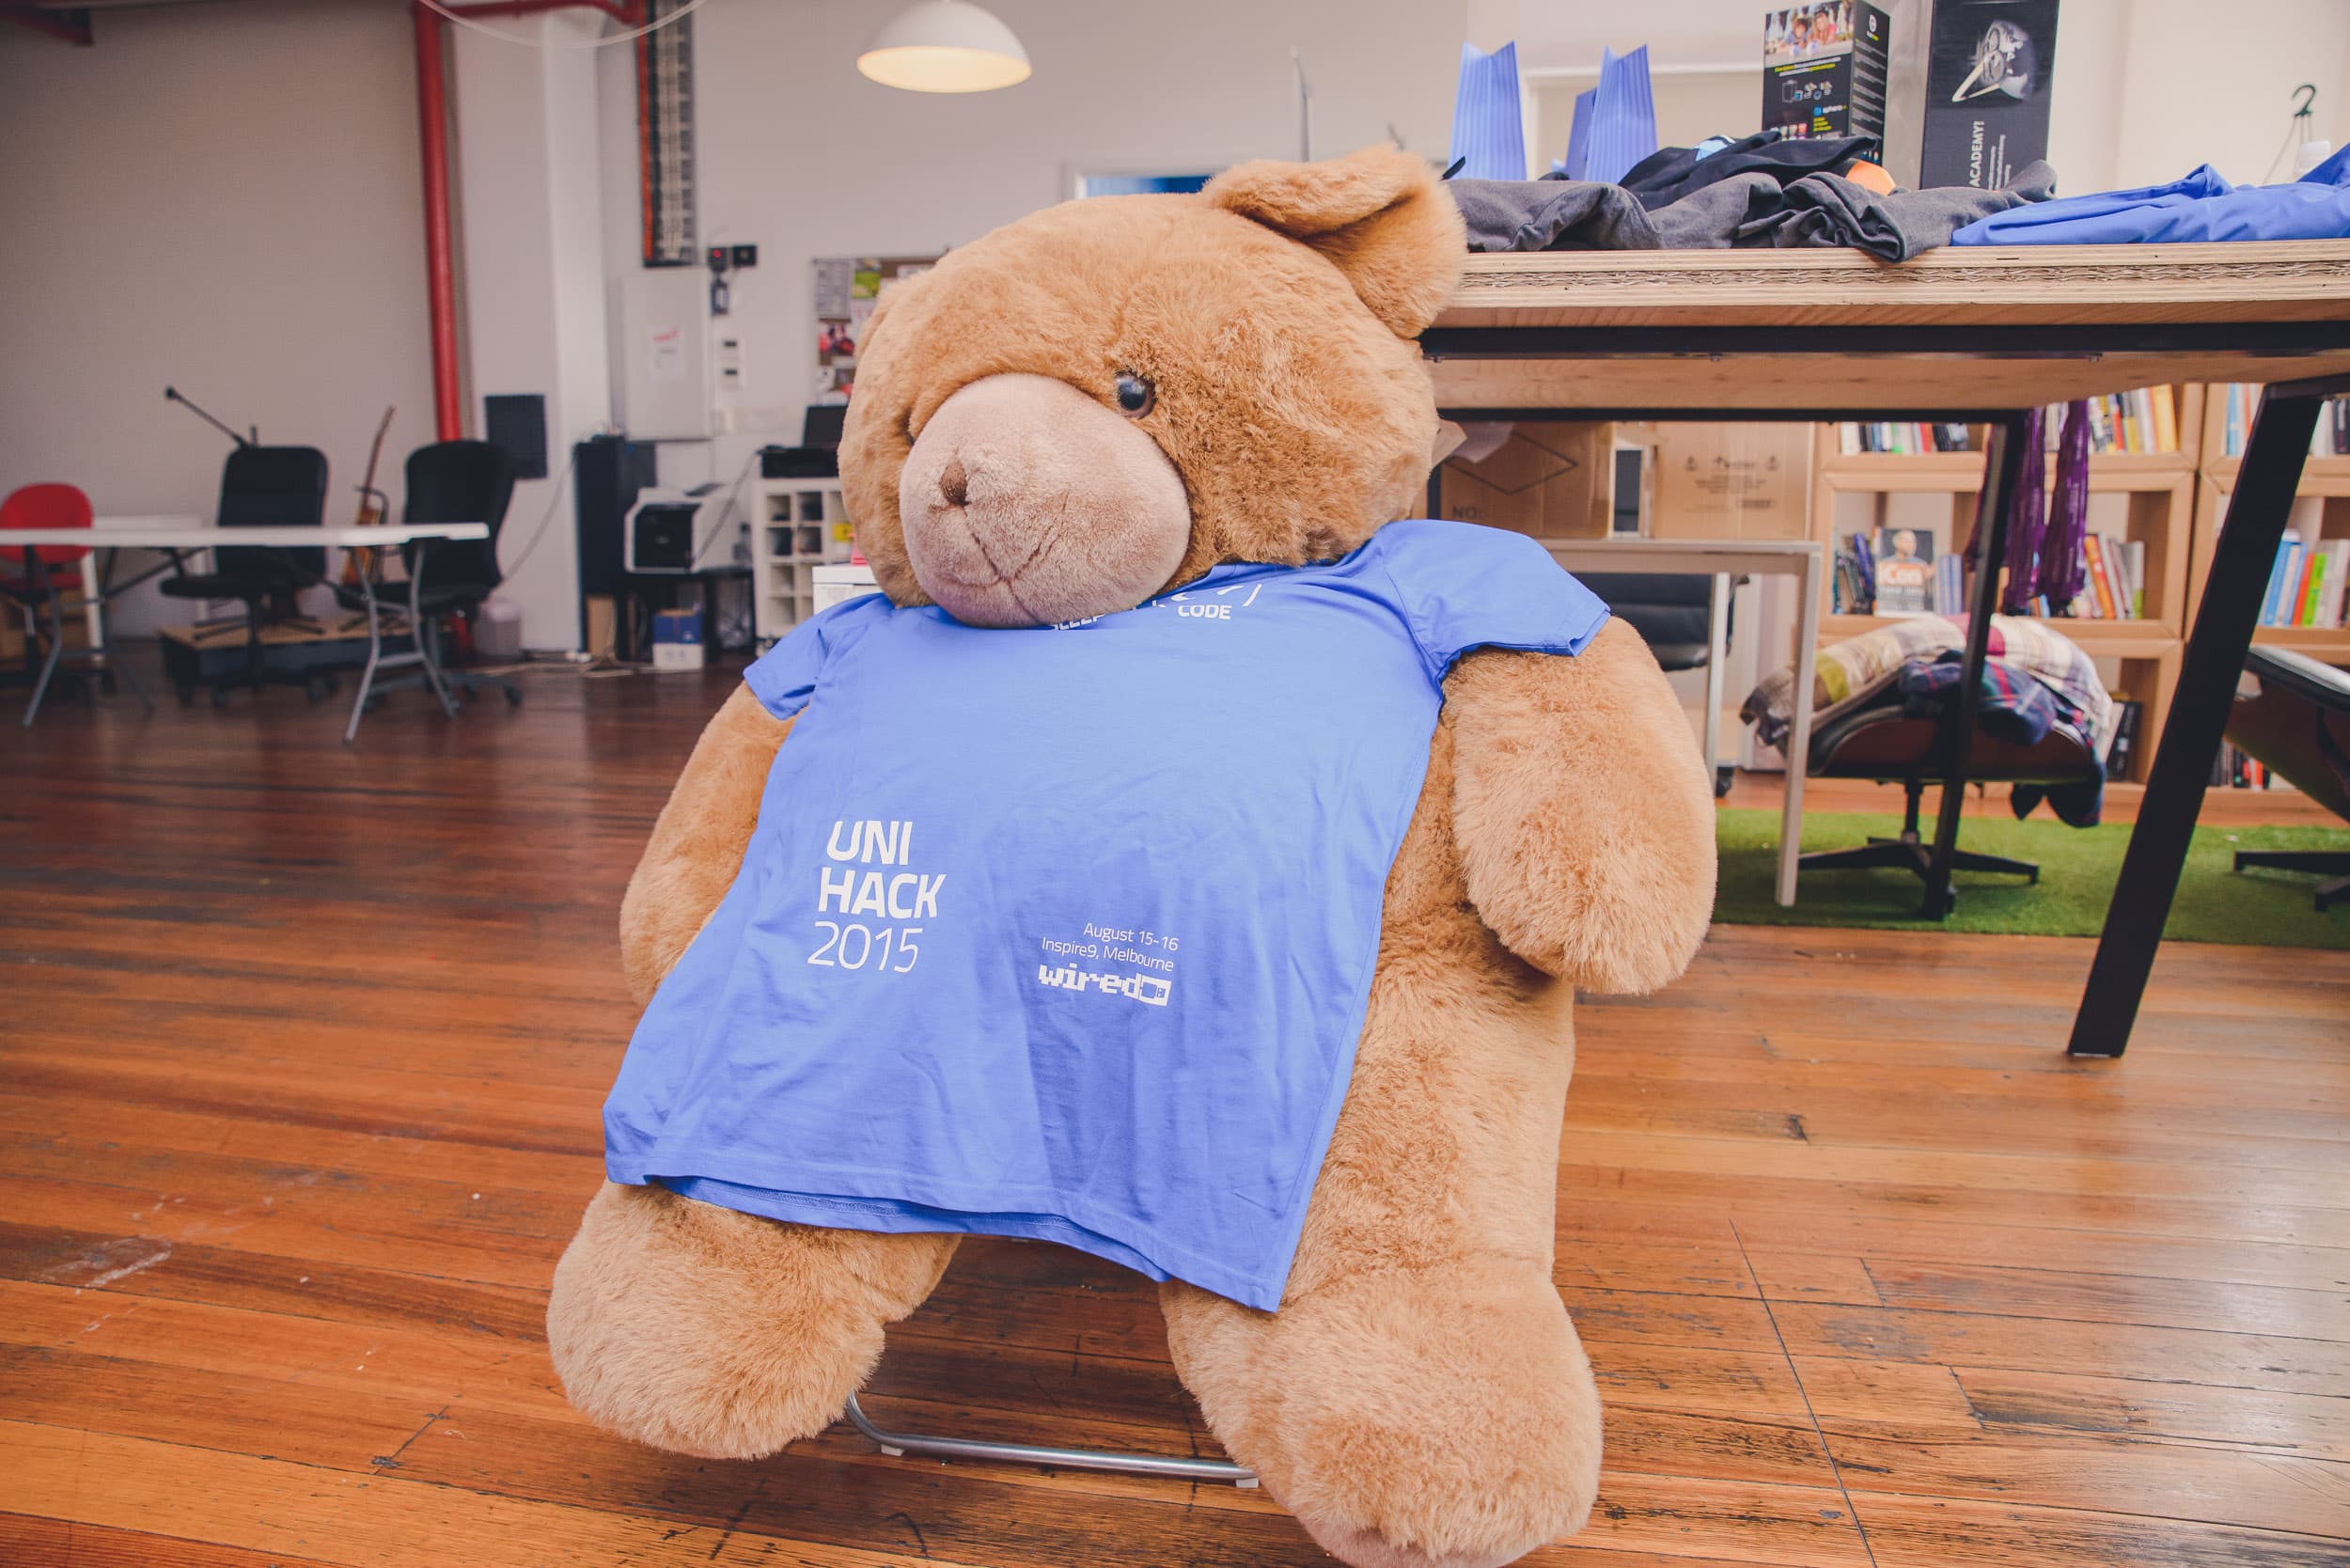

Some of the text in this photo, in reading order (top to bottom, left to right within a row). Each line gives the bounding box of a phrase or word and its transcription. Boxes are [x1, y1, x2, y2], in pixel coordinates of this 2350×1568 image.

[1968, 120, 1984, 187] ACADEMY!
[1178, 604, 1231, 620] CODE
[827, 820, 914, 866] UNI
[818, 867, 947, 919] HACK
[807, 920, 923, 973] 2015
[1042, 936, 1174, 972] Inspire9, Melbourne
[1083, 922, 1180, 951] August 15-16
